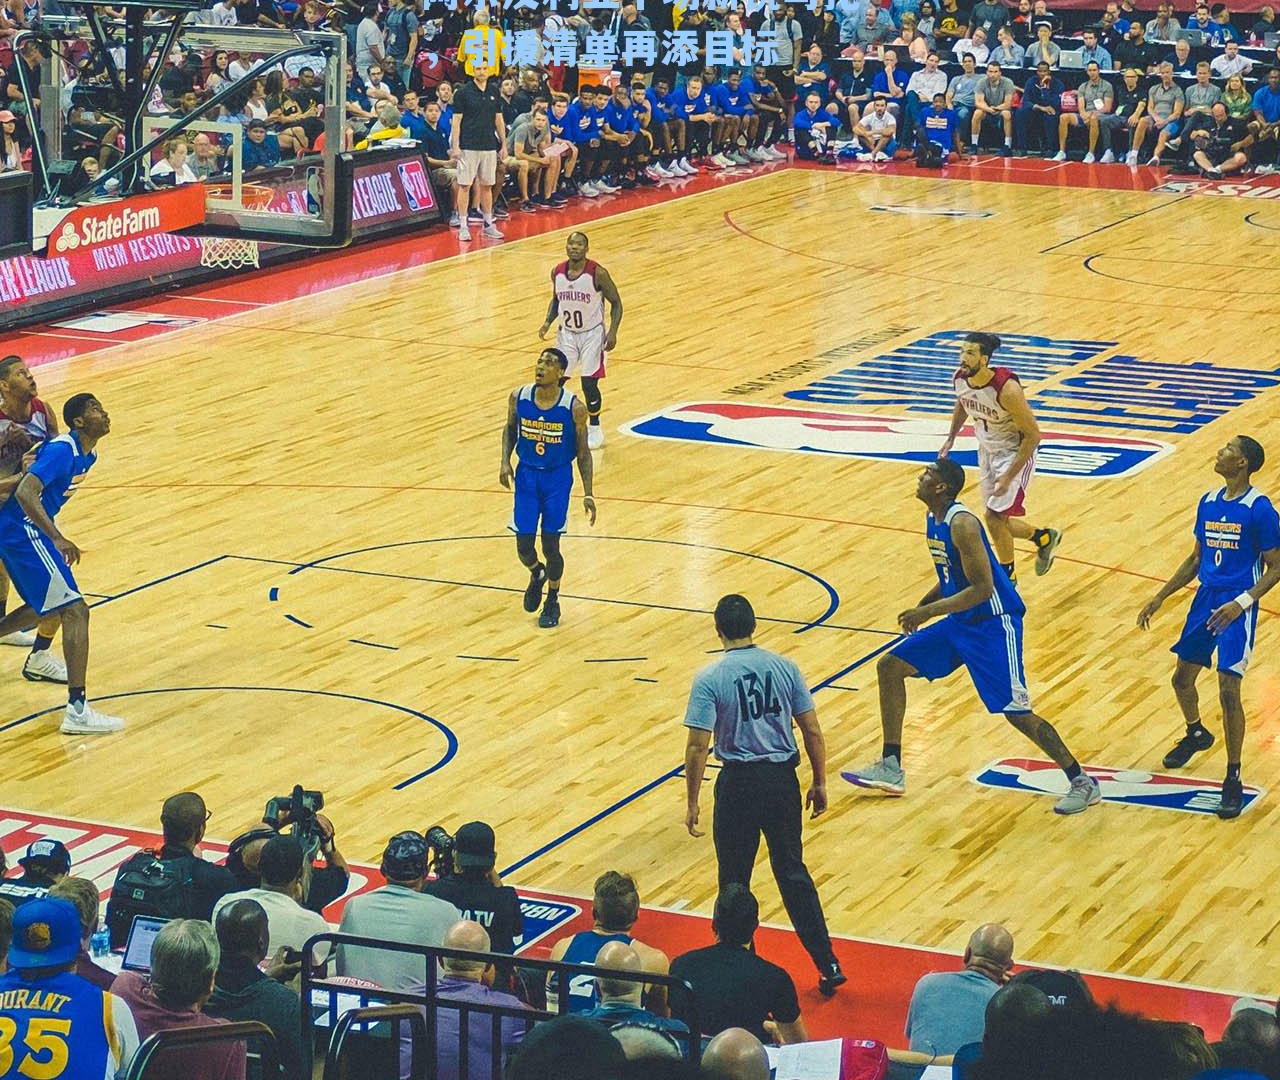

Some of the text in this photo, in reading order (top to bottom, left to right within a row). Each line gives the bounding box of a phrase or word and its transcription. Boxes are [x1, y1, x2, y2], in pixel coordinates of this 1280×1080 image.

[359, 172, 402, 221] LEAGUE
[19, 256, 76, 297] LEAGUE
[91, 245, 128, 271] MGM
[131, 233, 191, 263] RESORTS
[563, 310, 583, 328] 20
[521, 417, 563, 431] WARRIORS
[535, 442, 545, 456] 6
[1215, 549, 1222, 567] 0
[734, 670, 782, 722] 134
